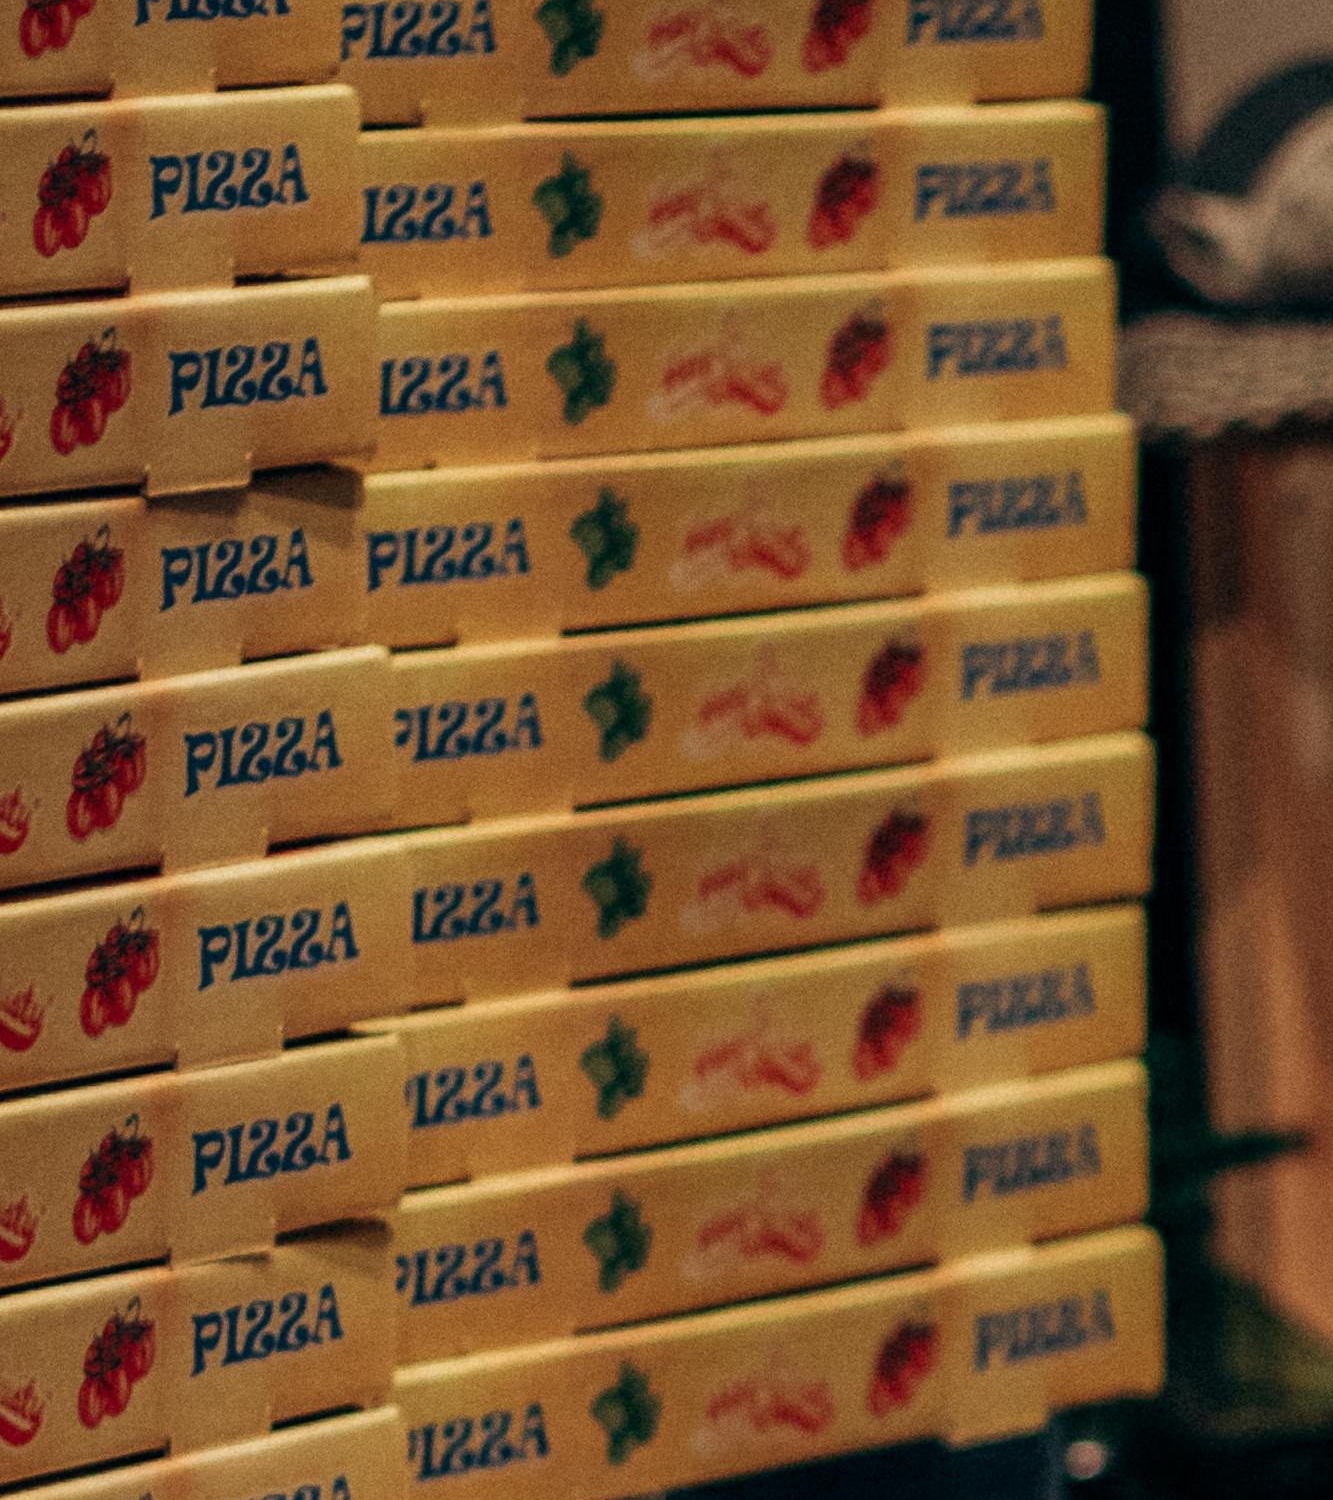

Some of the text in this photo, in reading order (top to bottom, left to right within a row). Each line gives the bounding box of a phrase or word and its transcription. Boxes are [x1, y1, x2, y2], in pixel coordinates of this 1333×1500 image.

[342, 0, 496, 58] PIZZA
[150, 146, 308, 217] PIZZA
[361, 183, 492, 243] IZZA
[913, 160, 1054, 220] PIZZA
[169, 339, 327, 414] PIZZA
[925, 317, 1065, 379] PIZZA
[379, 352, 508, 416] IZZA
[161, 530, 313, 609] PIZZA
[367, 520, 530, 590] PIZZA
[184, 712, 342, 794] PIZZA
[411, 874, 540, 944] IZZA
[198, 904, 358, 988] PIZZA
[404, 1057, 541, 1129] IZZA
[192, 1106, 352, 1192] PIZZA
[192, 1285, 344, 1374] PIZZA
[407, 1405, 550, 1481] IZZA
